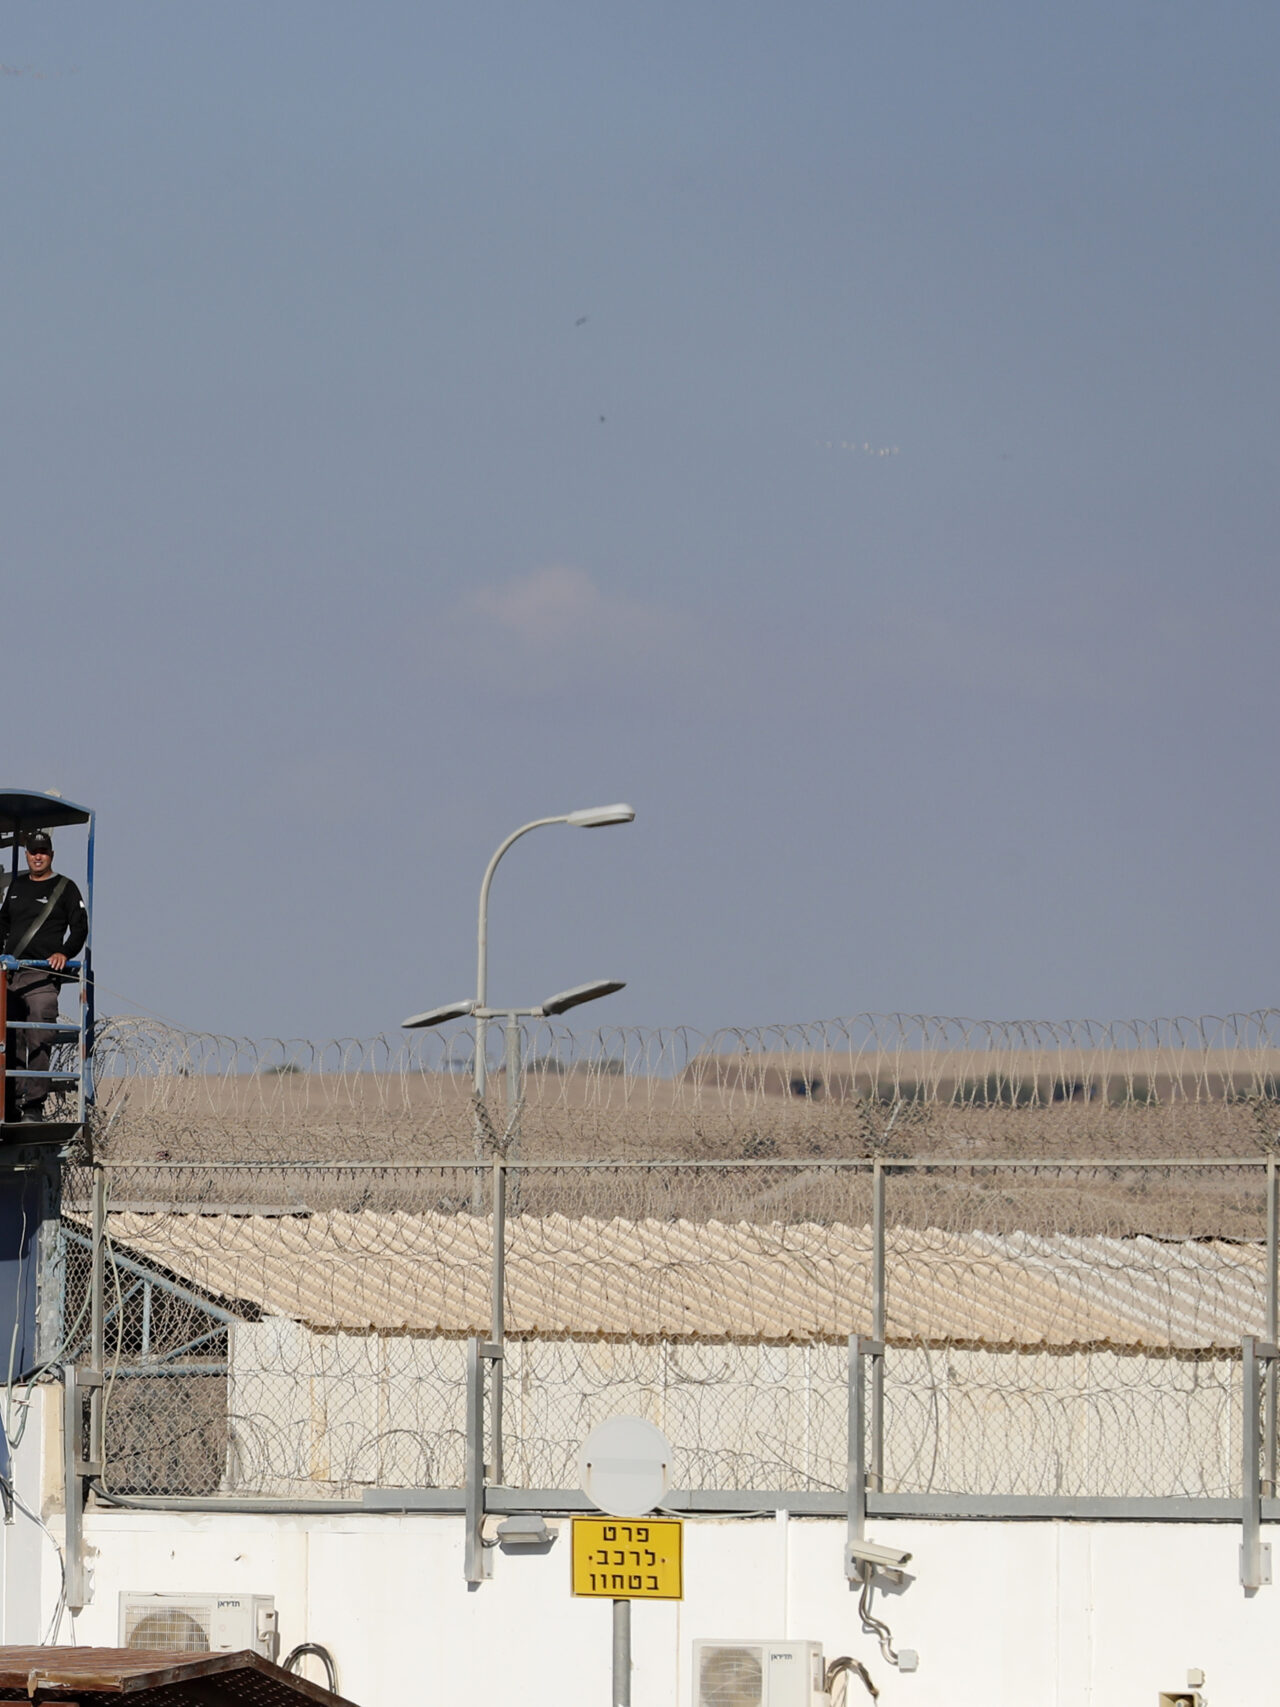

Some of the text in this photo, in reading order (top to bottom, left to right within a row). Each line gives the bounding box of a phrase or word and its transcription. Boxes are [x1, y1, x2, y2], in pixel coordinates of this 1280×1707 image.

[603, 1526, 649, 1543] פרט
[596, 1549, 656, 1567] לרכב
[589, 1573, 660, 1591] בטחון
